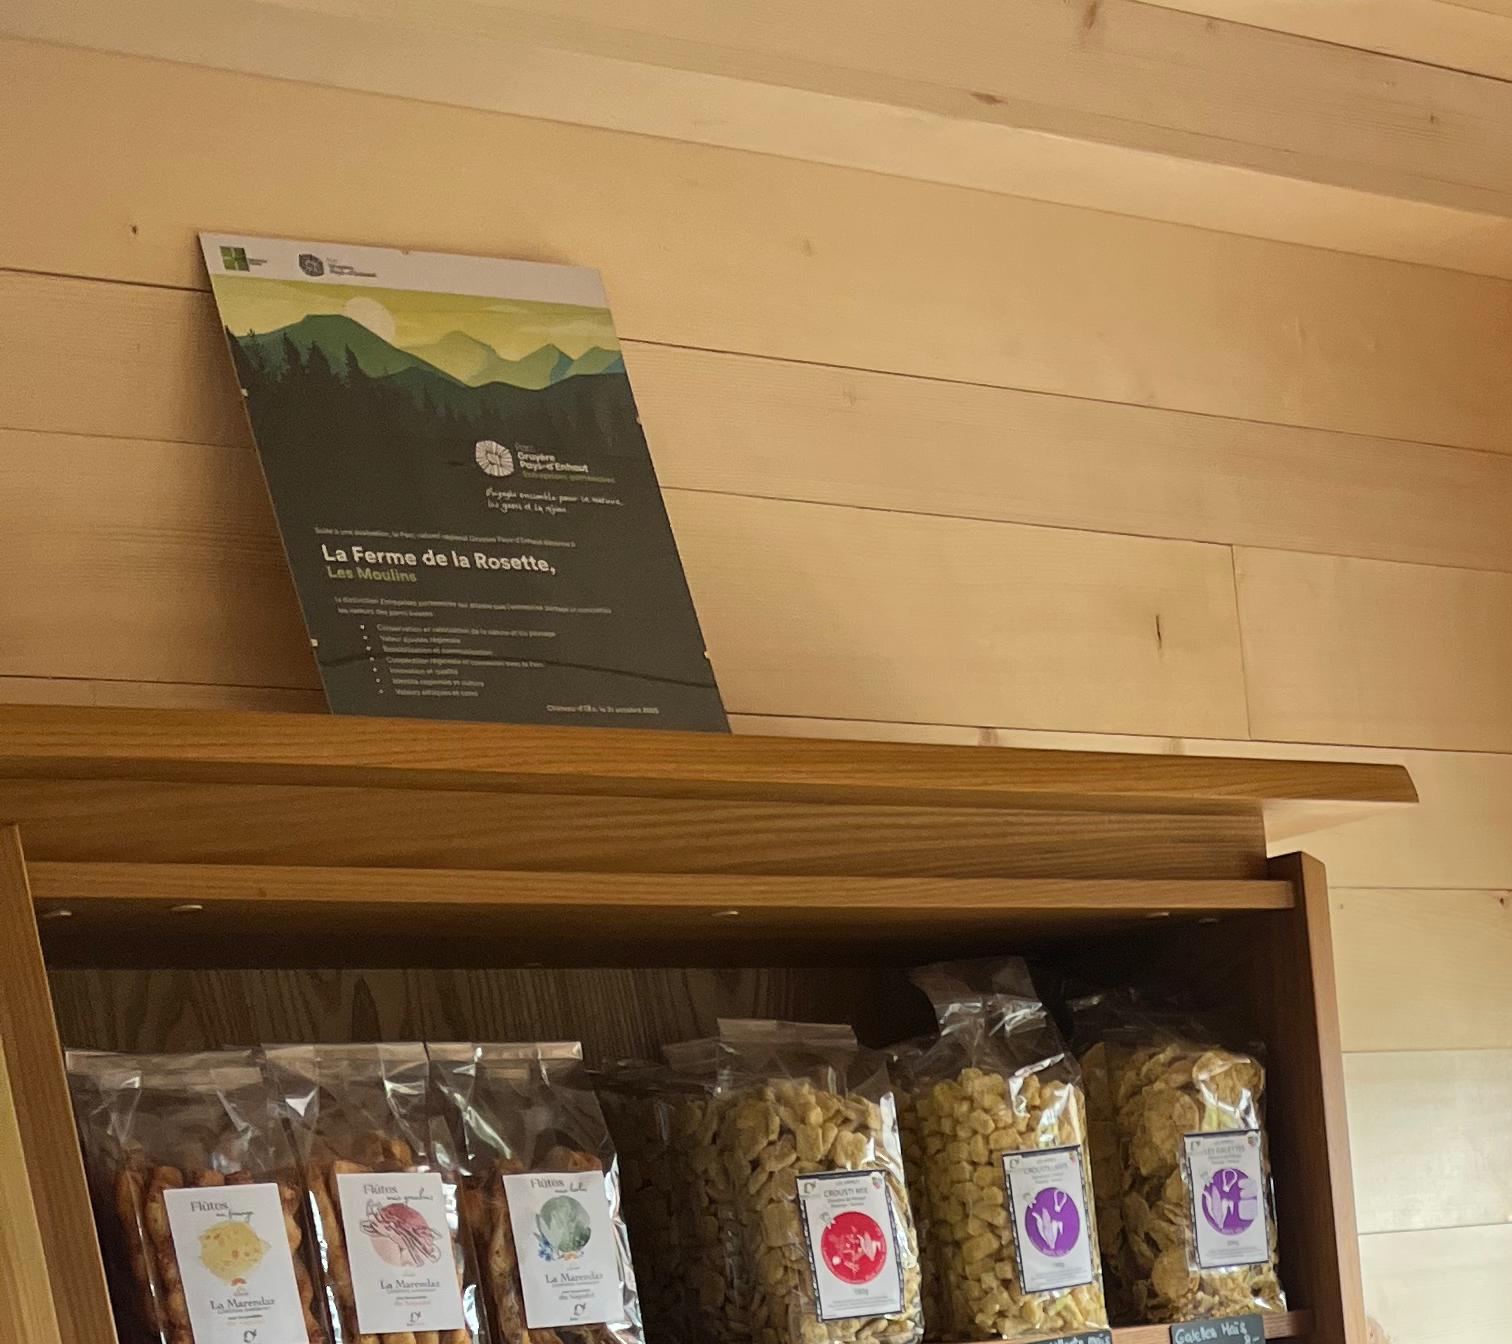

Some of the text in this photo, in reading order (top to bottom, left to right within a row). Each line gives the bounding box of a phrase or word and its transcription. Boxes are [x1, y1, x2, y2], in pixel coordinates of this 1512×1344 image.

[321, 544, 557, 575] La Ferme de la Rosette,
[327, 565, 417, 583] Les Moulins
